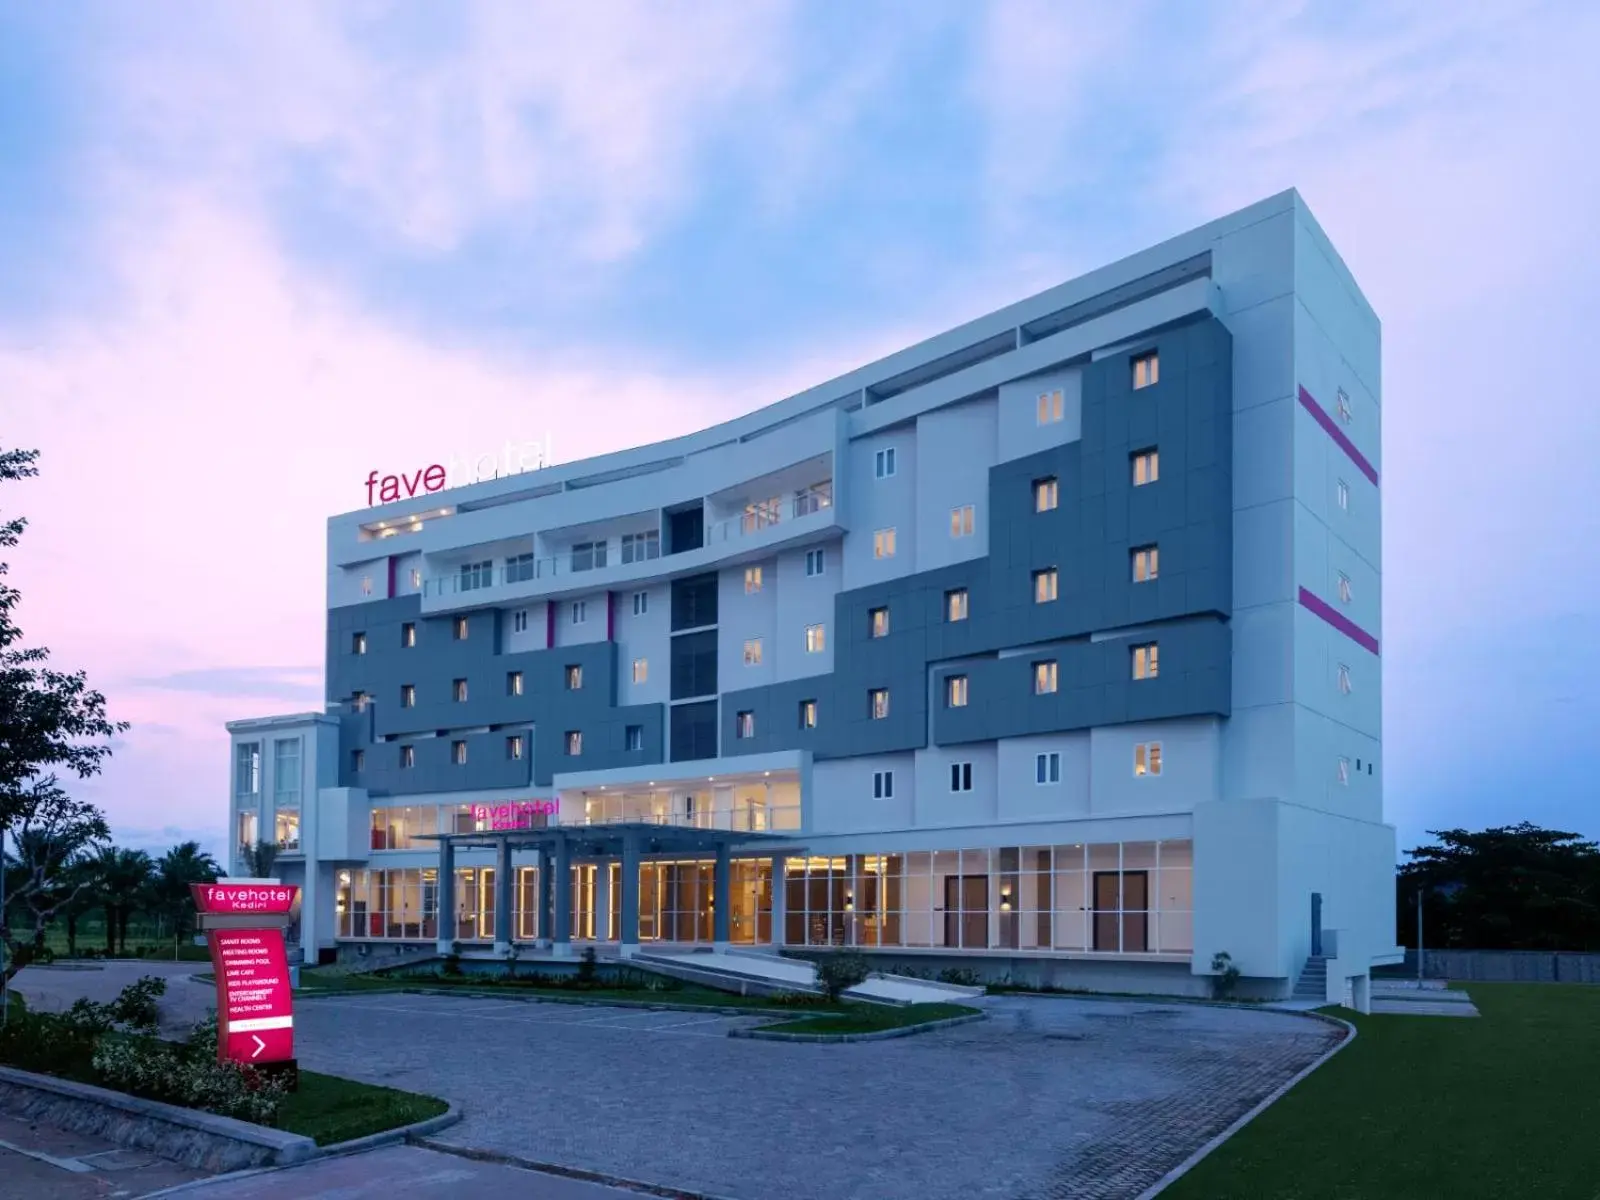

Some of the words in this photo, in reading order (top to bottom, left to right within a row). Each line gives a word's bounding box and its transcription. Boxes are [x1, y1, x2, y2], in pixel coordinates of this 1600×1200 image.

[469, 798, 560, 820] favehotel
[207, 888, 290, 901] favehotel
[232, 901, 267, 909] Kediri
